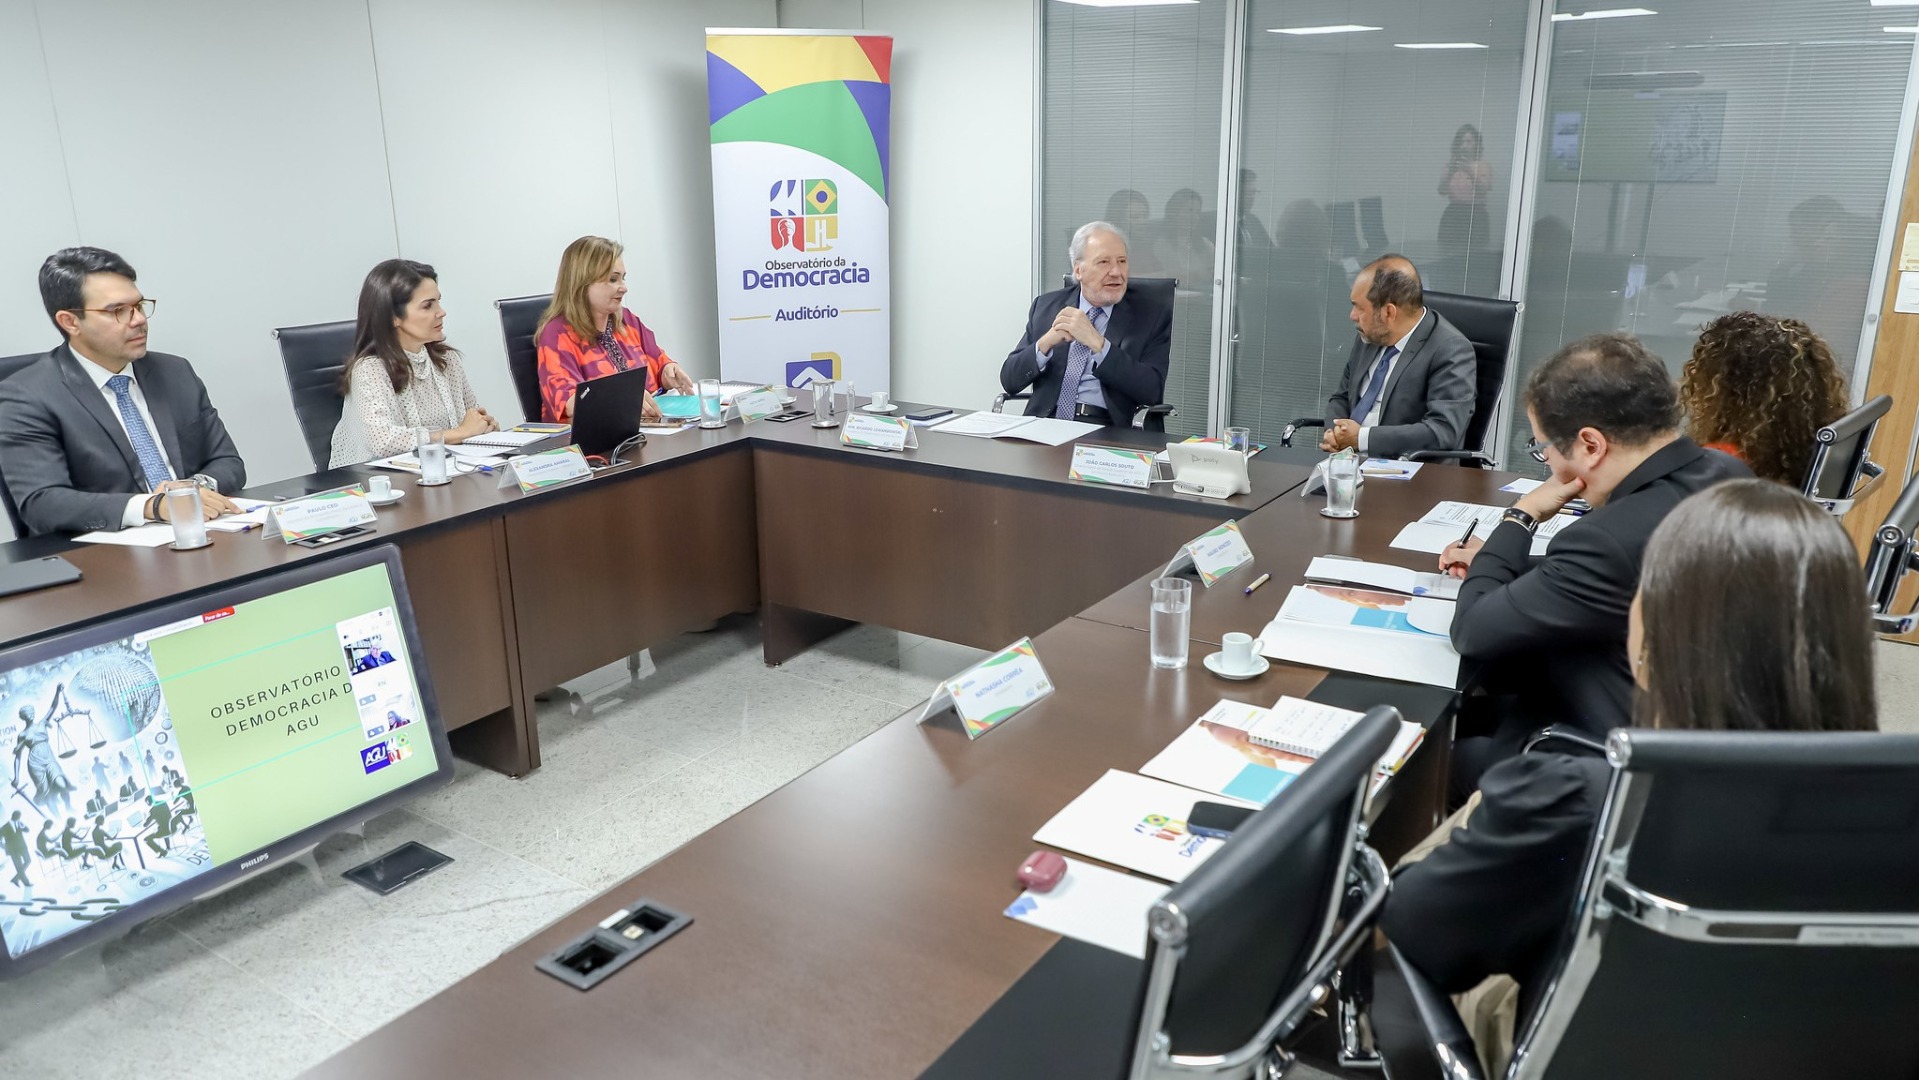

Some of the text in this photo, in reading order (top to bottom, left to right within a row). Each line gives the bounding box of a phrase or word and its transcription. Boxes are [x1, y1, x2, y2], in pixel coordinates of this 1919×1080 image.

[765, 256, 846, 271] Observatório da
[742, 261, 870, 291] Democracia
[775, 305, 839, 322] Auditório
[210, 665, 341, 719] OBSERVATÓRIO
[226, 688, 339, 737] DEMOCRACIA
[286, 714, 319, 736] AGU
[364, 744, 388, 766] AGU
[240, 852, 270, 870] PHILIPS
